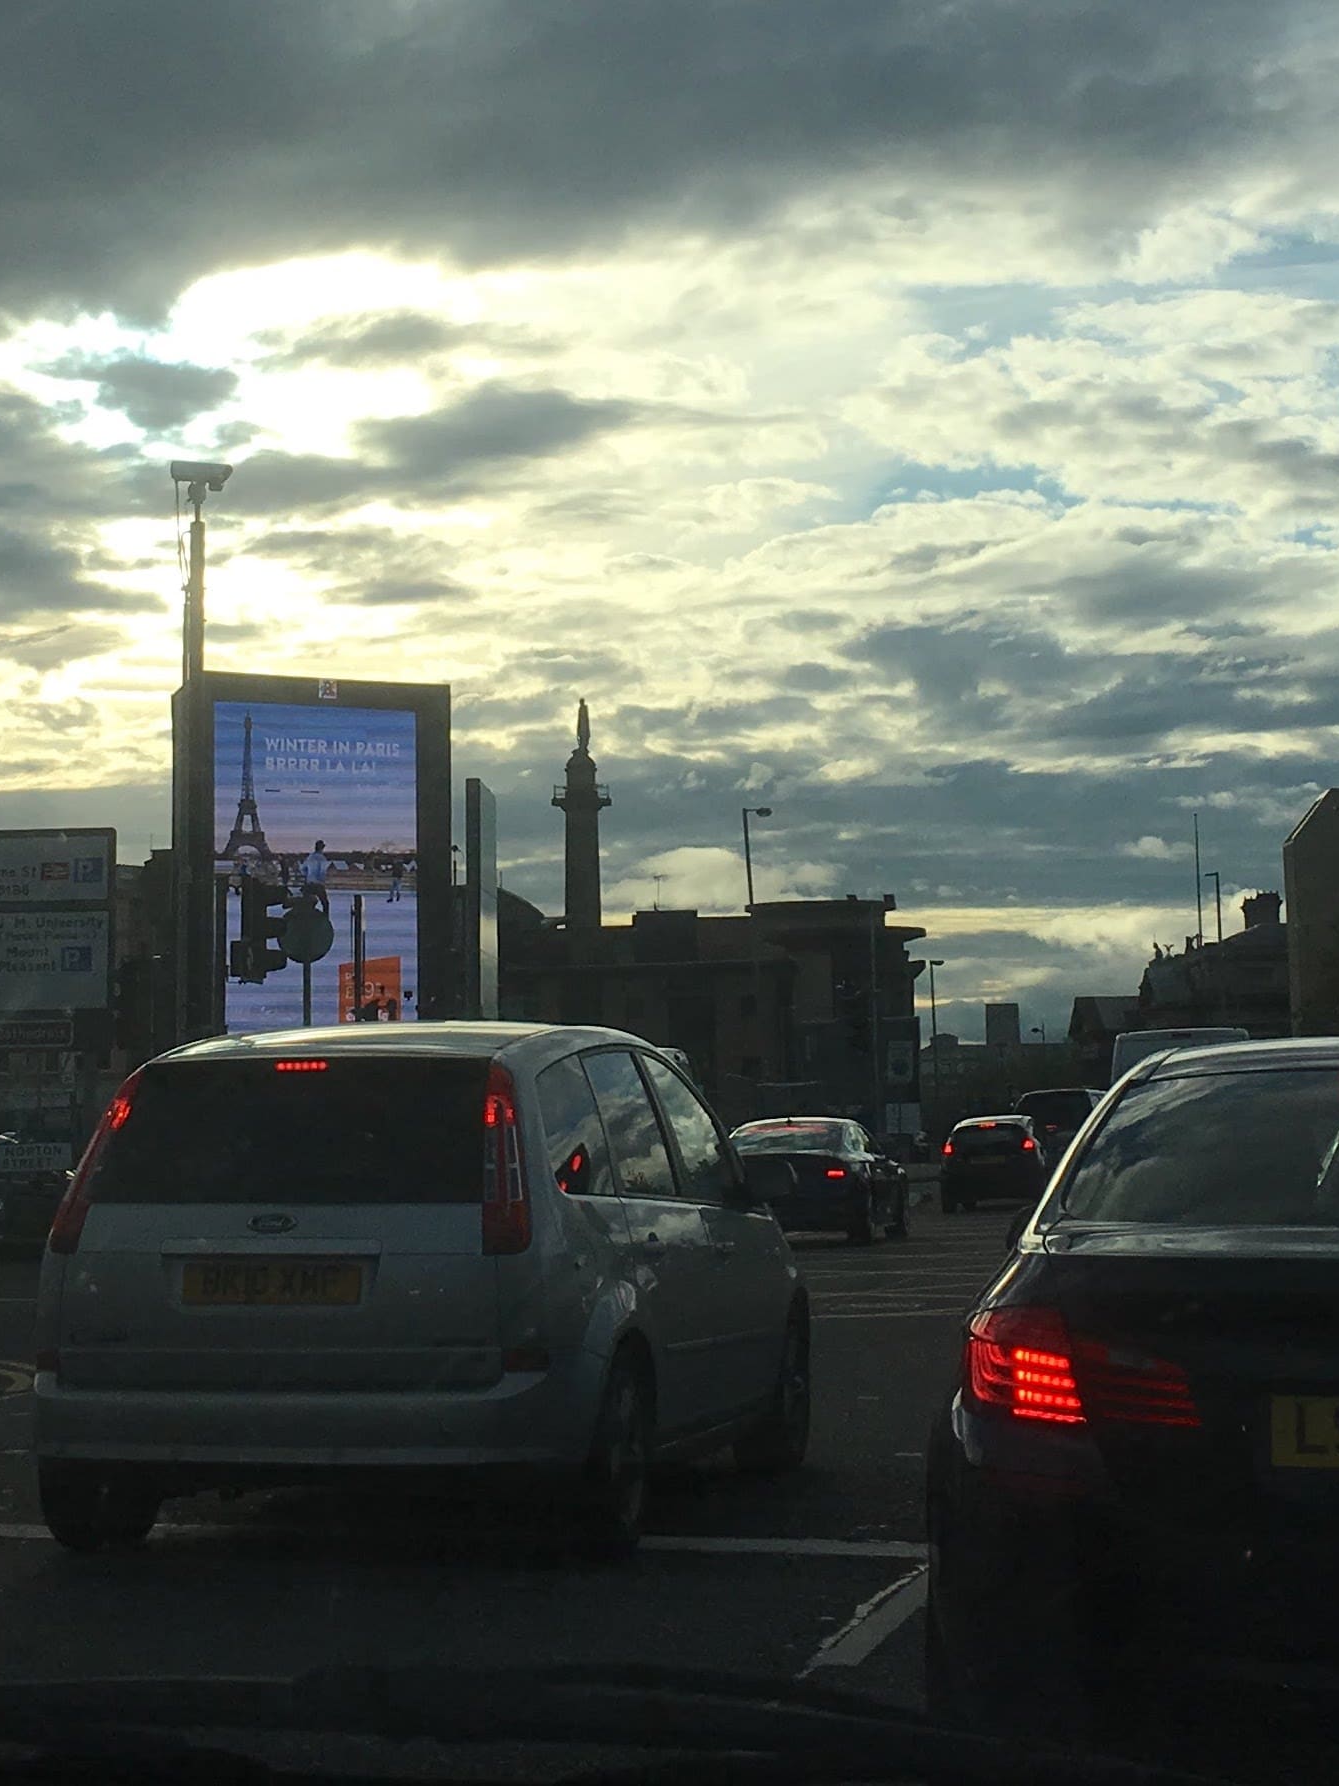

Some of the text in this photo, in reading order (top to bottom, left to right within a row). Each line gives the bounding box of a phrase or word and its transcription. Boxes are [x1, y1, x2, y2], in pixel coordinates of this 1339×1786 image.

[264, 737, 400, 758] WINTER IN PARIS
[265, 756, 376, 775] BRRRR LA LA!
[21, 865, 37, 878] St
[36, 916, 103, 930] University
[6, 946, 49, 958] Mount
[4, 1145, 62, 1157] NORTON
[2, 1157, 53, 1169] STREET
